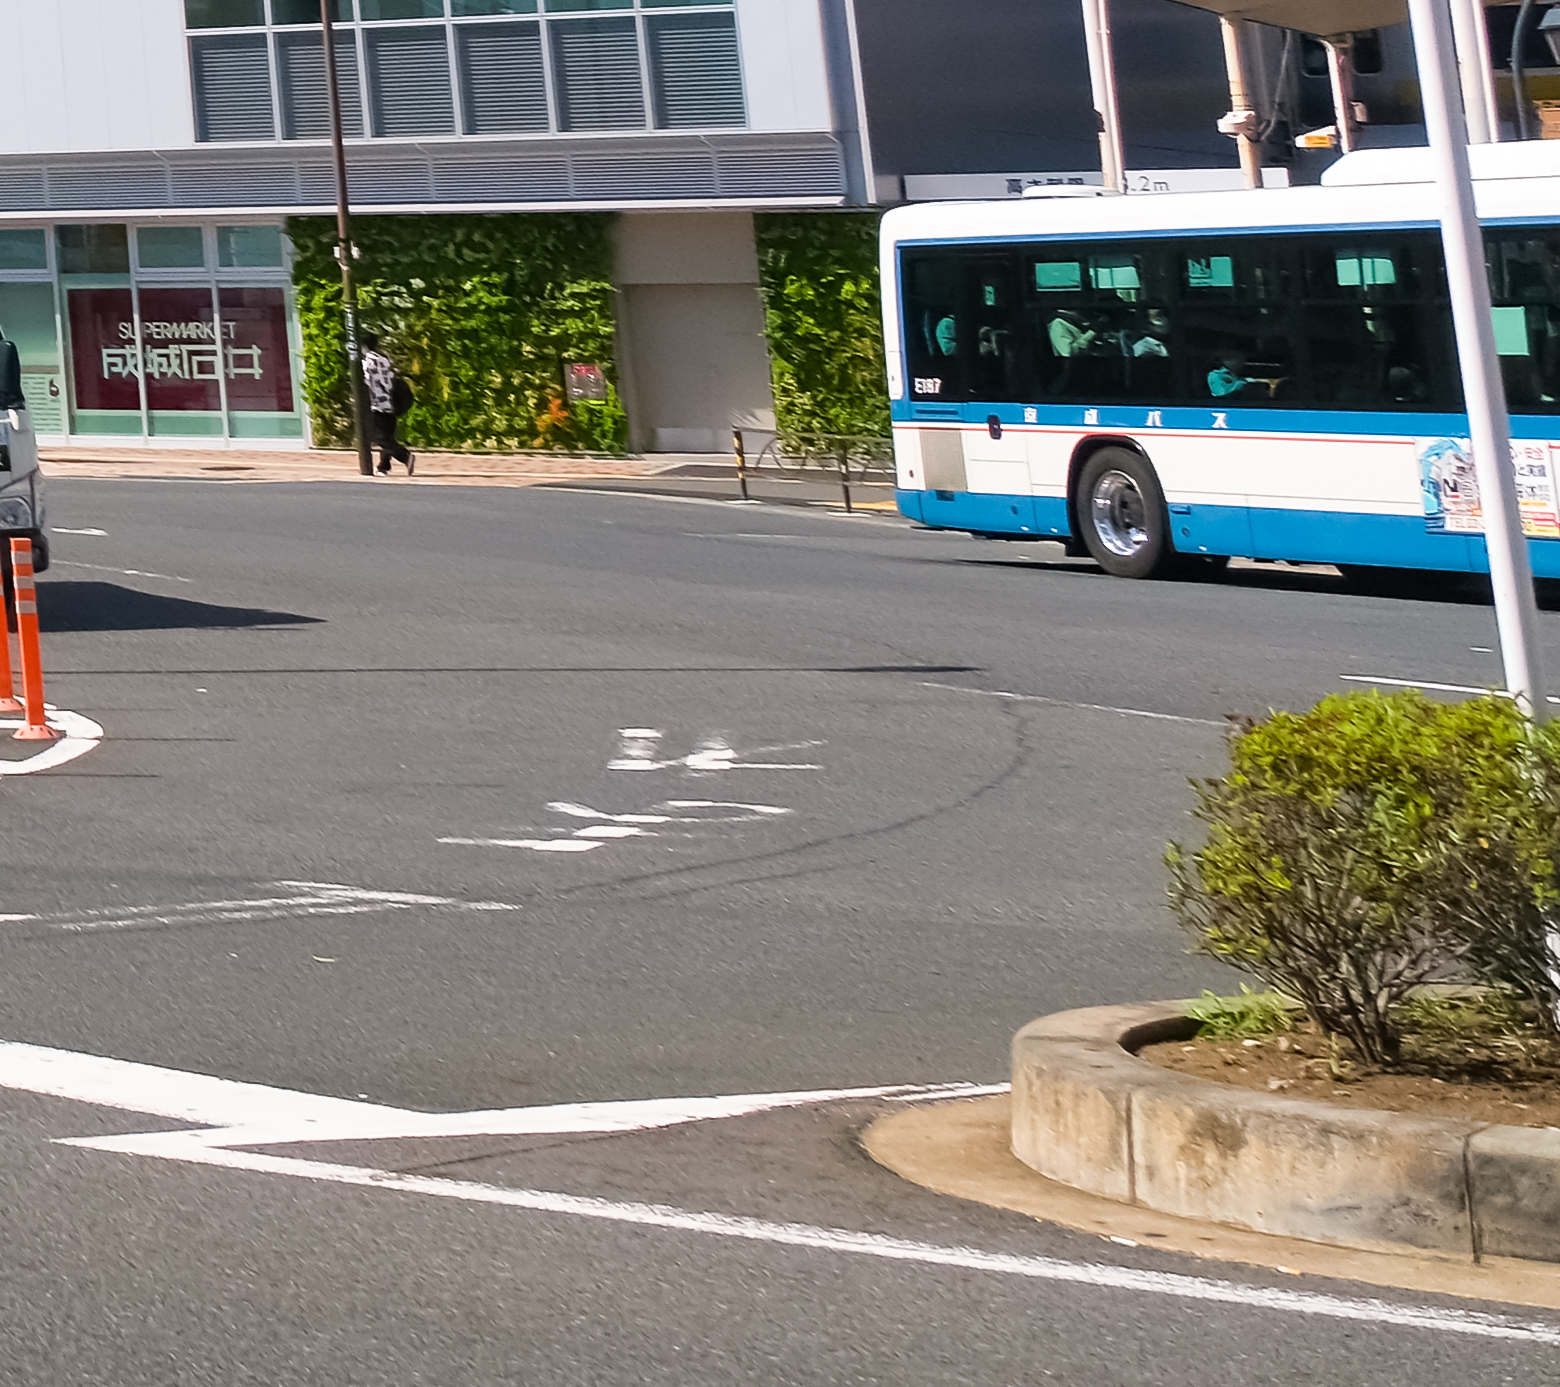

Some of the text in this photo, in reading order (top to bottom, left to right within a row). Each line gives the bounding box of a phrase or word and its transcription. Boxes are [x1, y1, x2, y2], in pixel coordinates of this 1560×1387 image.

[117, 321, 237, 340] SUPERMARKET
[102, 343, 263, 381] 成城石井
